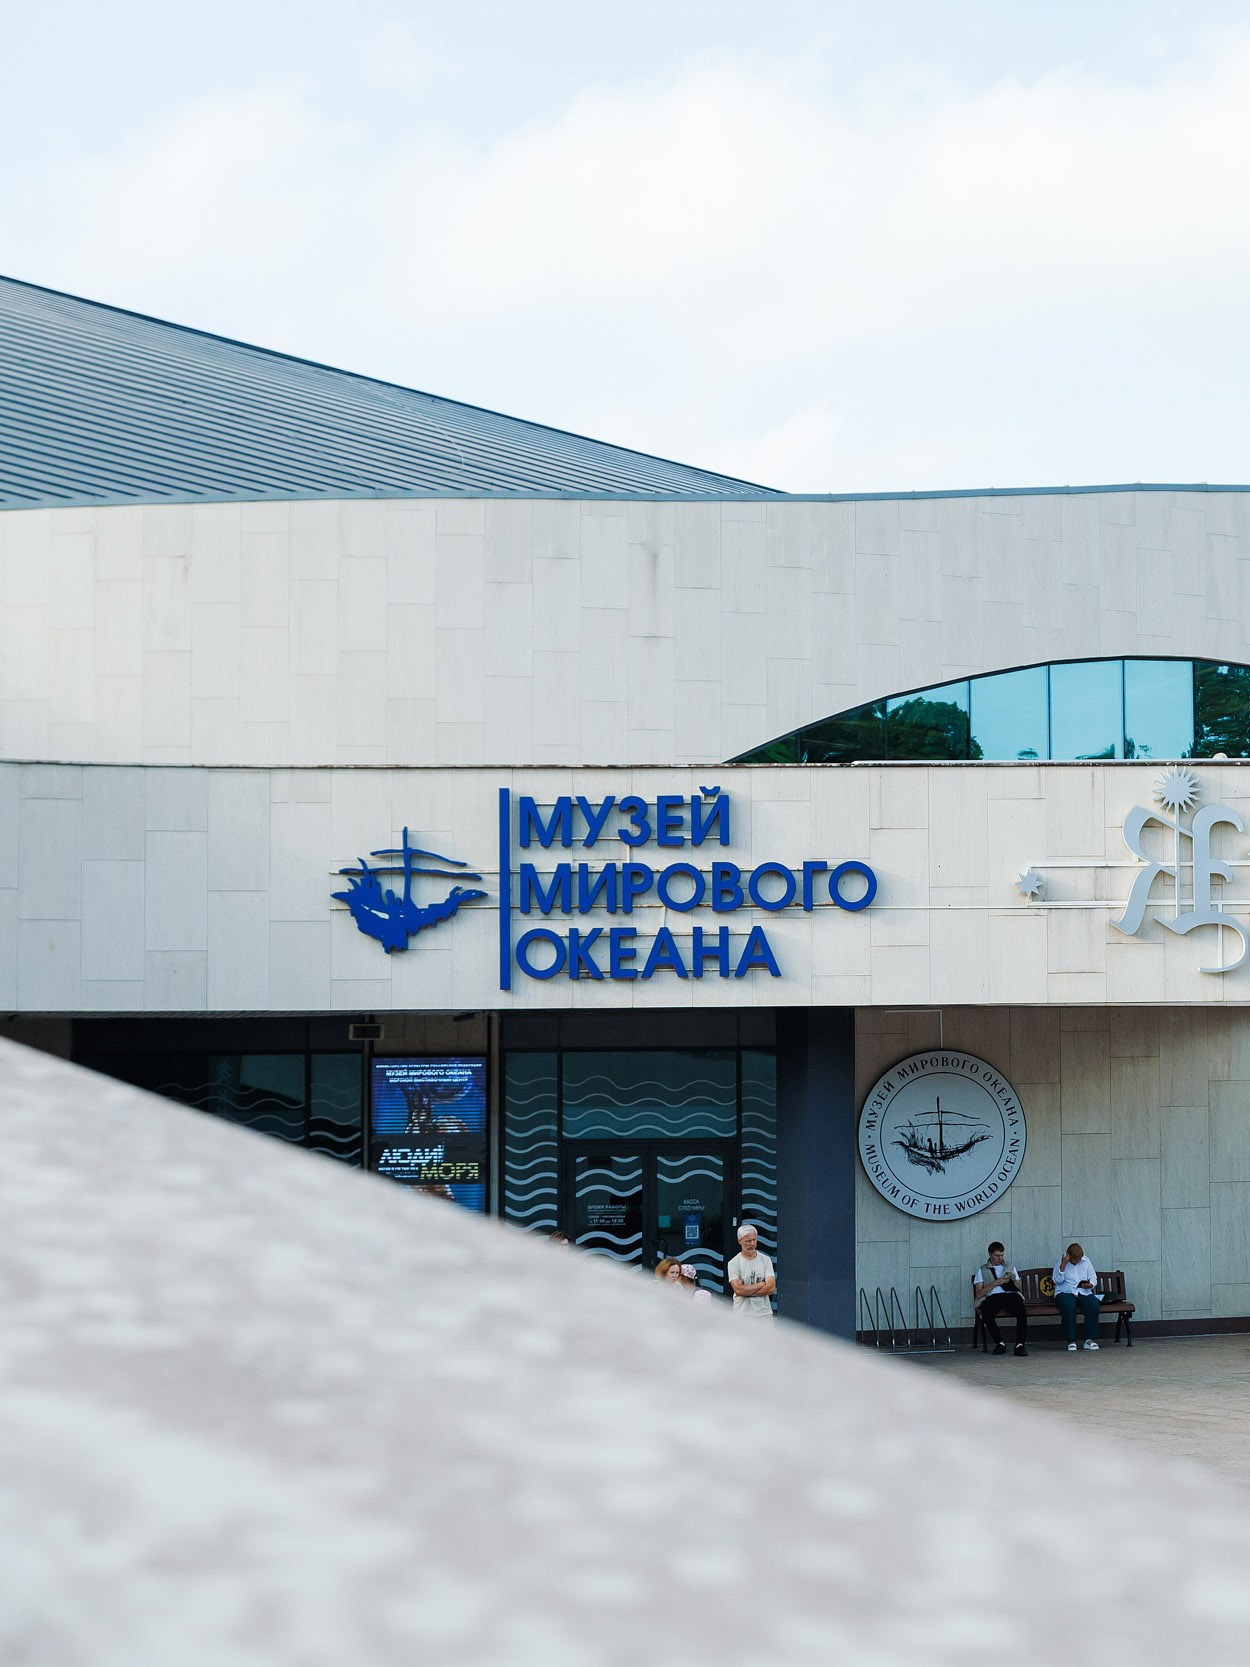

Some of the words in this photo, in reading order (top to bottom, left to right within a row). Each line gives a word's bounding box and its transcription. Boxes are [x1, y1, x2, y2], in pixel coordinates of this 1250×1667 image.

[518, 785, 731, 848] МУЗЕЙ
[518, 860, 878, 914] МИРОВОГО
[515, 925, 782, 980] ОКЕАНА
[865, 1080, 895, 1131] МУЗЕЙ
[897, 1056, 980, 1081] МИРОВОГО
[982, 1071, 1020, 1128] ОКЕАНА
[864, 1142, 902, 1200] MUSEUM
[901, 1194, 920, 1208] OF
[924, 1202, 951, 1215] THE
[954, 1181, 999, 1213] WORLD
[997, 1137, 1021, 1182] OCEAN
